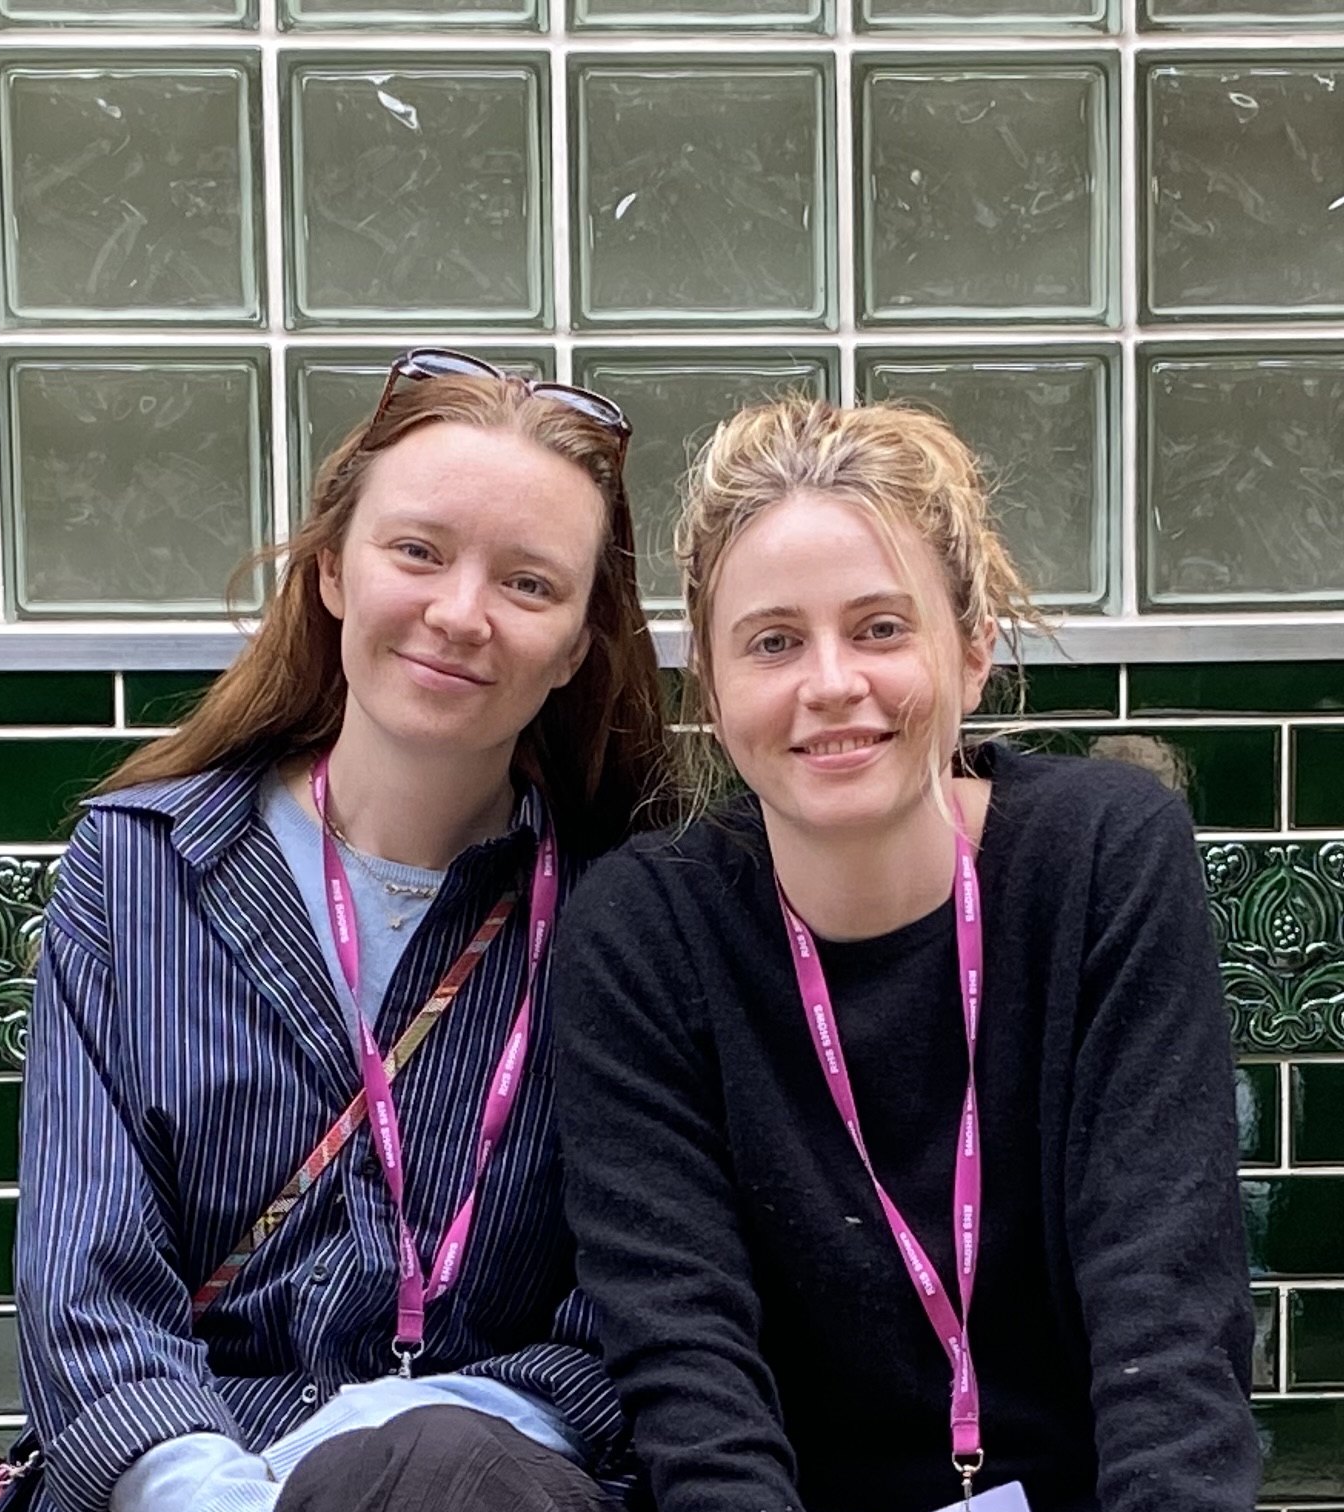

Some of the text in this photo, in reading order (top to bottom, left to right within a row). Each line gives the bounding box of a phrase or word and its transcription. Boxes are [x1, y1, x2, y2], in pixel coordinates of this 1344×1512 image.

[963, 880, 975, 922] SHOWS
[498, 1032, 522, 1096] RHS SHOWS
[813, 1004, 839, 1074] RHS SHOWS
[376, 1101, 395, 1169] RHS SHOWS
[441, 1242, 458, 1282] SHOWS
[900, 1231, 936, 1296] RHS SHOWS
